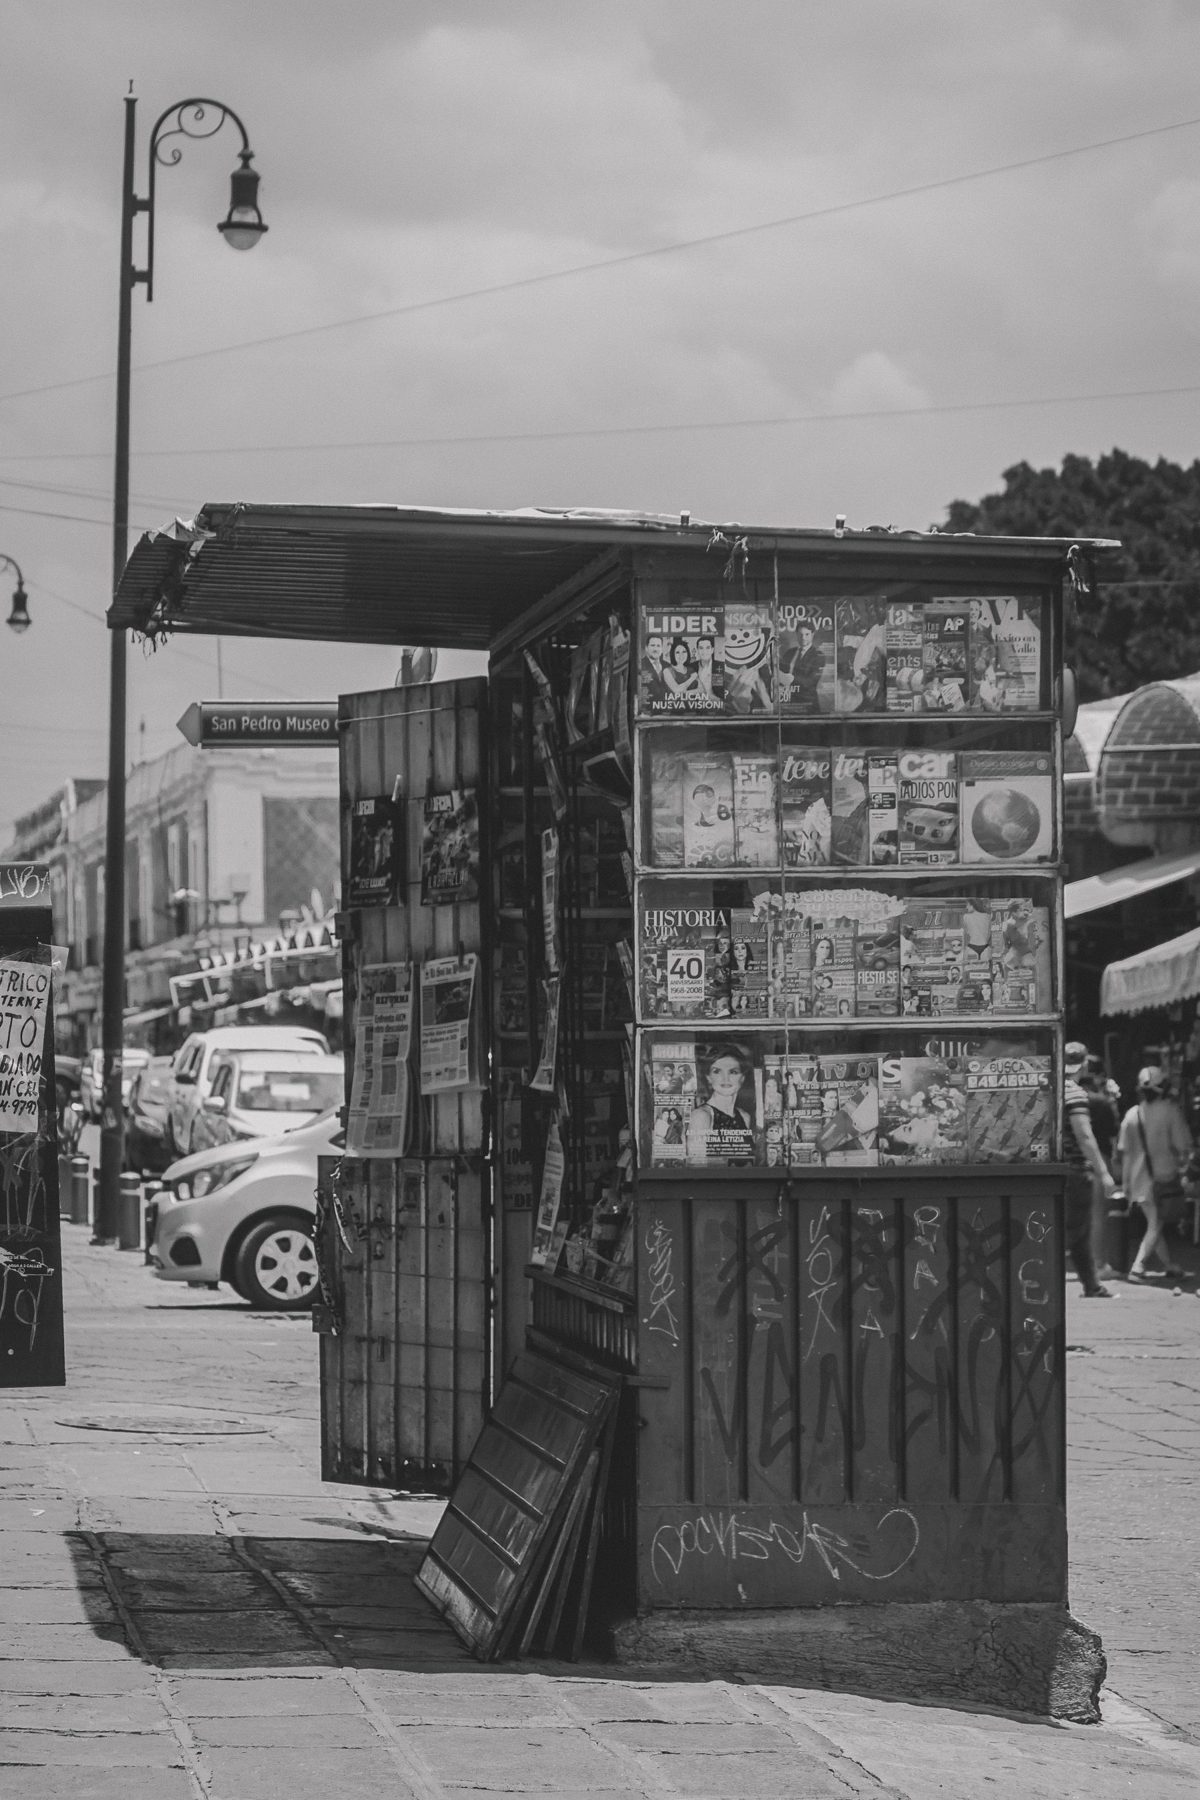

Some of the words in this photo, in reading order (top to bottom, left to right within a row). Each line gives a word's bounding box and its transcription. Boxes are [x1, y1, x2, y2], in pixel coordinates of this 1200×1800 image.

[648, 615, 717, 633] LIDER
[778, 617, 833, 632] CUVO
[652, 700, 686, 709] NUEVA
[212, 715, 236, 731] San
[241, 714, 281, 731] Pedro
[286, 715, 330, 731] Museo
[644, 909, 727, 927] HISTORIA
[644, 926, 651, 937] Y
[670, 957, 703, 980] 40
[857, 970, 885, 985] FIESTA
[989, 1061, 1026, 1073] BUSCA
